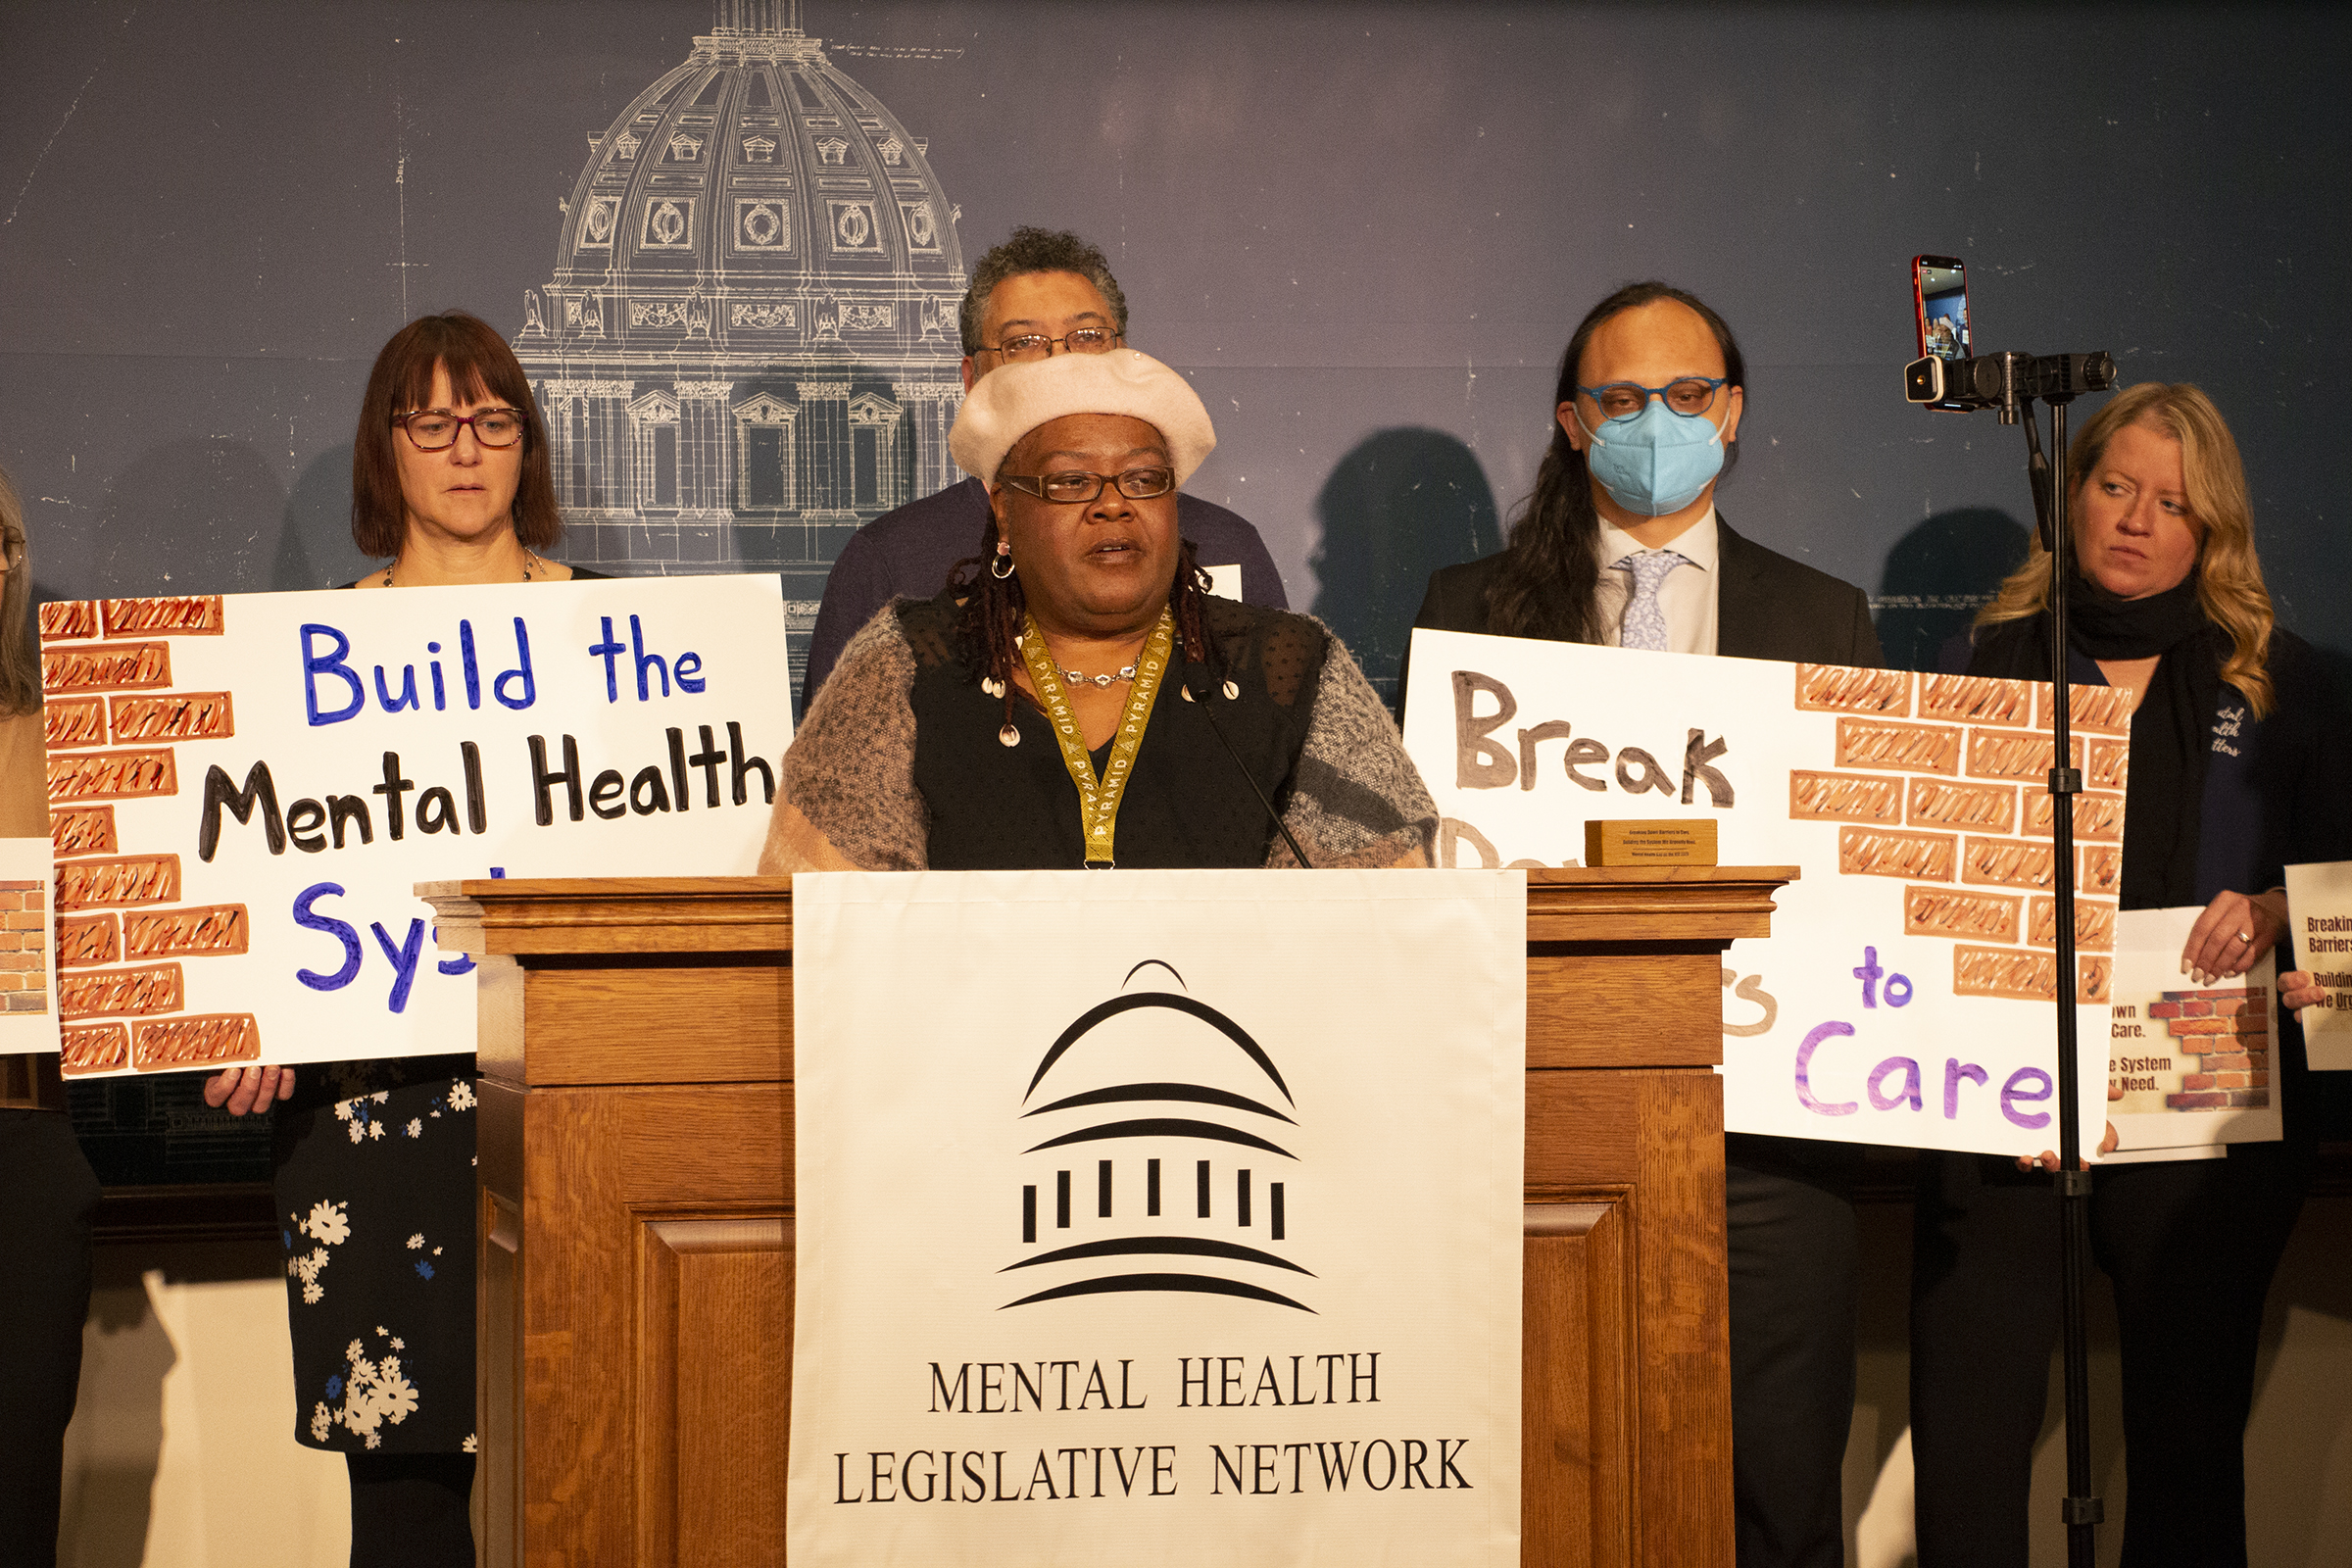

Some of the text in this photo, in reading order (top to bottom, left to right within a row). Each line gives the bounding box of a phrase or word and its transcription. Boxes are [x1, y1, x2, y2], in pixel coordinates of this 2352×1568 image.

[300, 614, 706, 726] Build the
[1035, 662, 1074, 735] PYRAMID
[1125, 661, 1159, 733] PYRAMID
[1451, 670, 1735, 808] Break
[199, 721, 774, 863] Mental Health
[1094, 760, 1127, 835] PYRAMID
[1853, 947, 1913, 1008] to
[1795, 1020, 2053, 1130] Care
[2120, 1056, 2172, 1074] System
[2121, 1076, 2159, 1092] Need.
[927, 1352, 1382, 1414] MENTAL HEALTH
[834, 1440, 1474, 1504] LEGISLATIVE NETWORK
